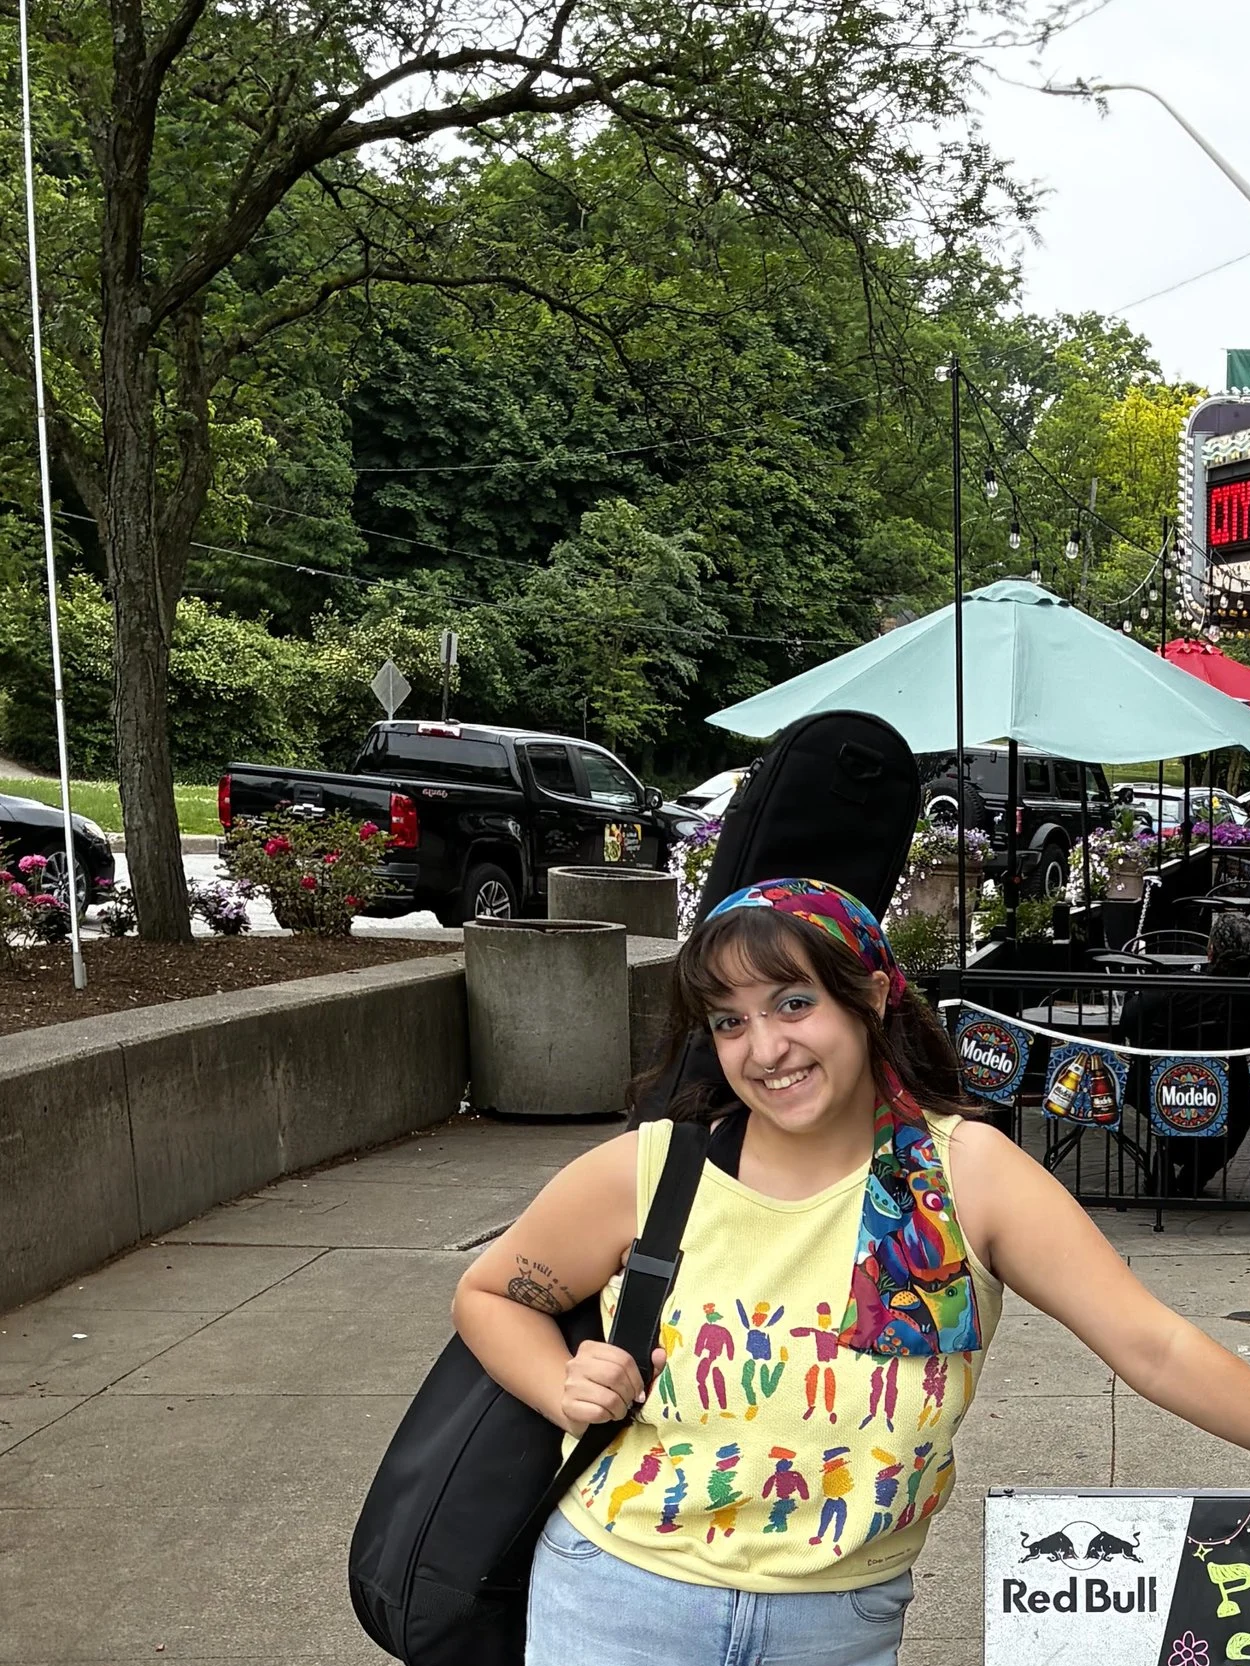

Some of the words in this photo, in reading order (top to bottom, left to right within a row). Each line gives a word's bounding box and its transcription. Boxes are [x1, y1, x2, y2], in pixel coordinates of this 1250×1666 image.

[960, 1037, 1013, 1074] Modelo
[1162, 1085, 1217, 1107] Modelo
[1003, 1576, 1079, 1613] Red
[1085, 1576, 1157, 1613] Bull
